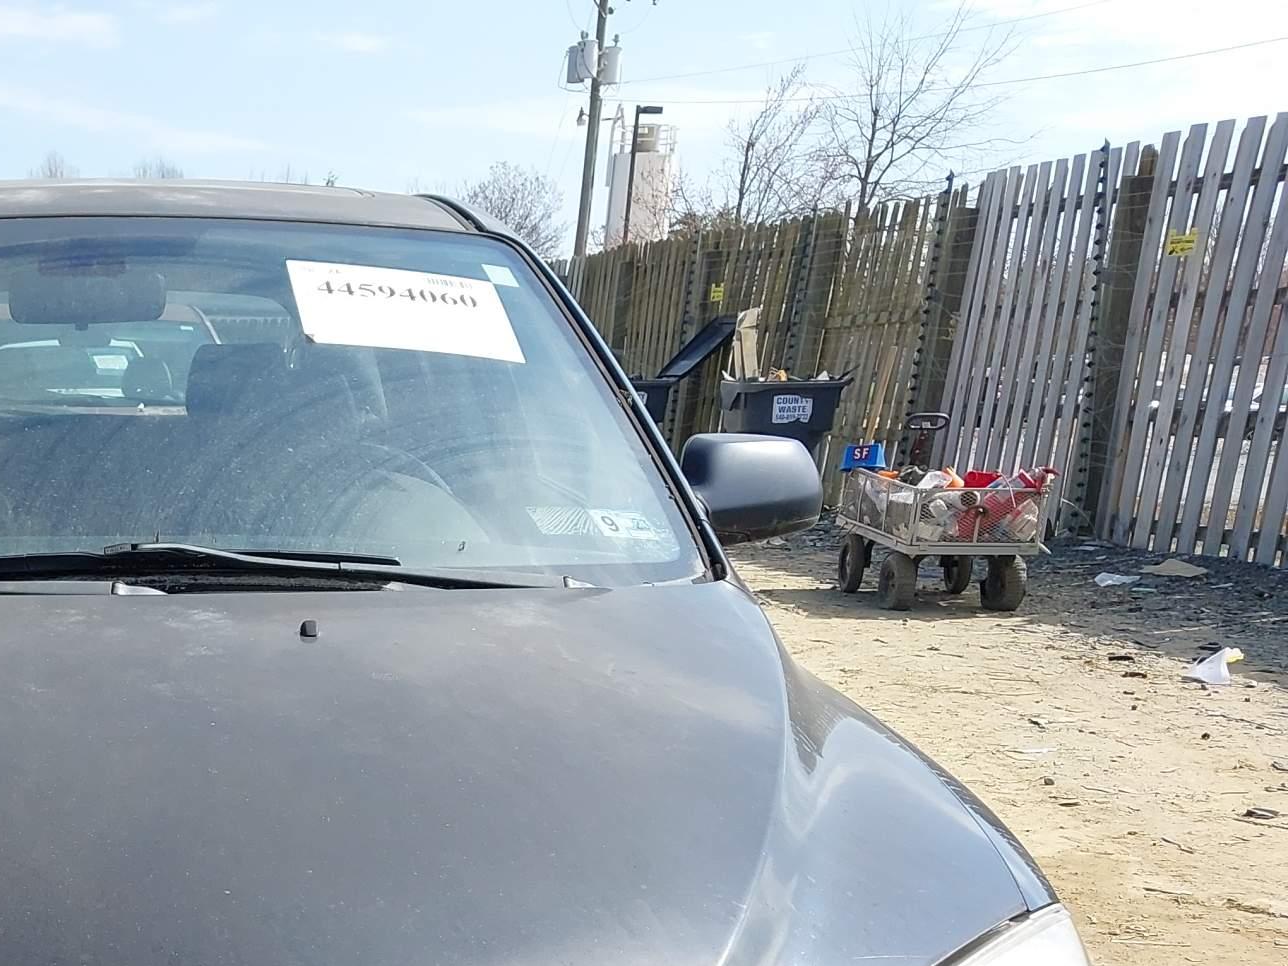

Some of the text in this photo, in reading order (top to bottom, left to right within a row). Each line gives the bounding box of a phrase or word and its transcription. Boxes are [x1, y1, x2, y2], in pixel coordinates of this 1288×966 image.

[317, 280, 478, 308] 44594060
[778, 405, 808, 413] WASTE
[854, 447, 870, 460] SF
[600, 515, 620, 532] 9
